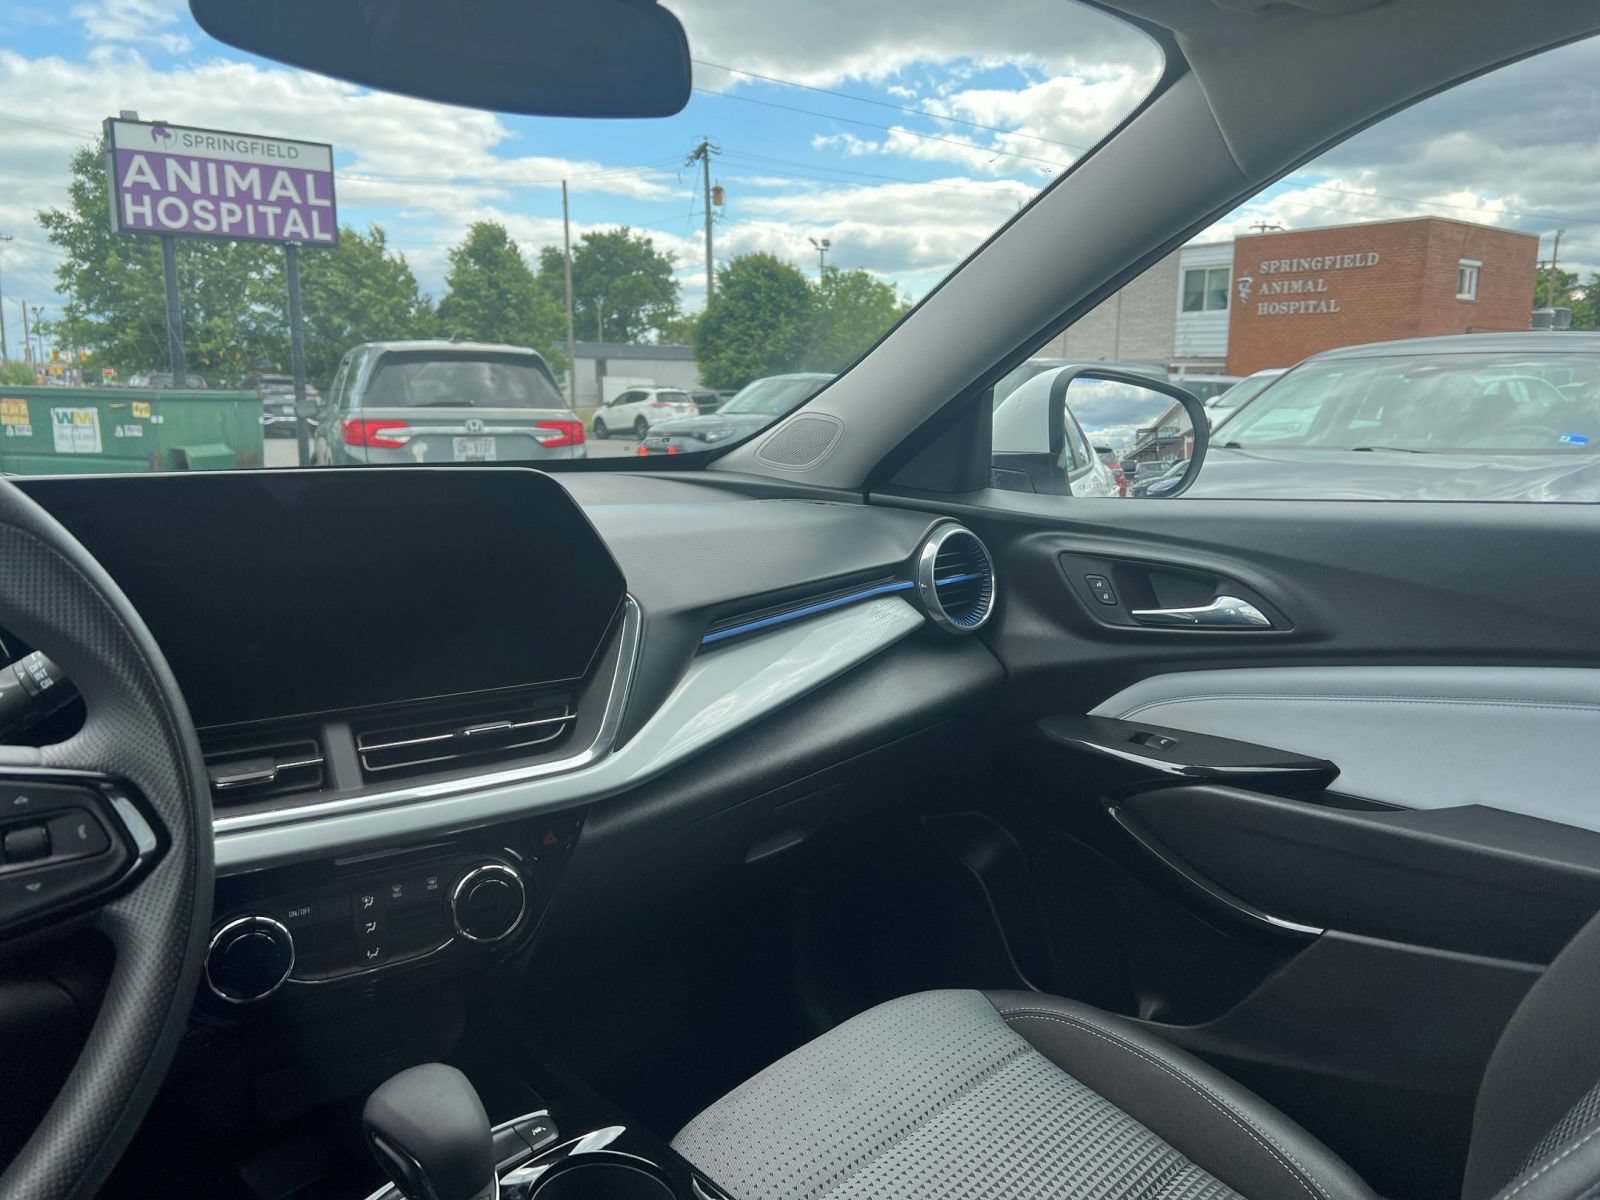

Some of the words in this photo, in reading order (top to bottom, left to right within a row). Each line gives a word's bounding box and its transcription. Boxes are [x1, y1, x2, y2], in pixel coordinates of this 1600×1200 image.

[182, 133, 299, 160] SPRINGFIELD
[122, 154, 332, 207] ANIMAL
[124, 193, 333, 241] HOSPITAL
[1259, 252, 1380, 274] SPRINGFIELD
[1258, 278, 1328, 296] ANIMAL
[1256, 299, 1341, 316] HOSPITAL
[55, 411, 92, 425] WM
[288, 907, 311, 918] ON/OFF
